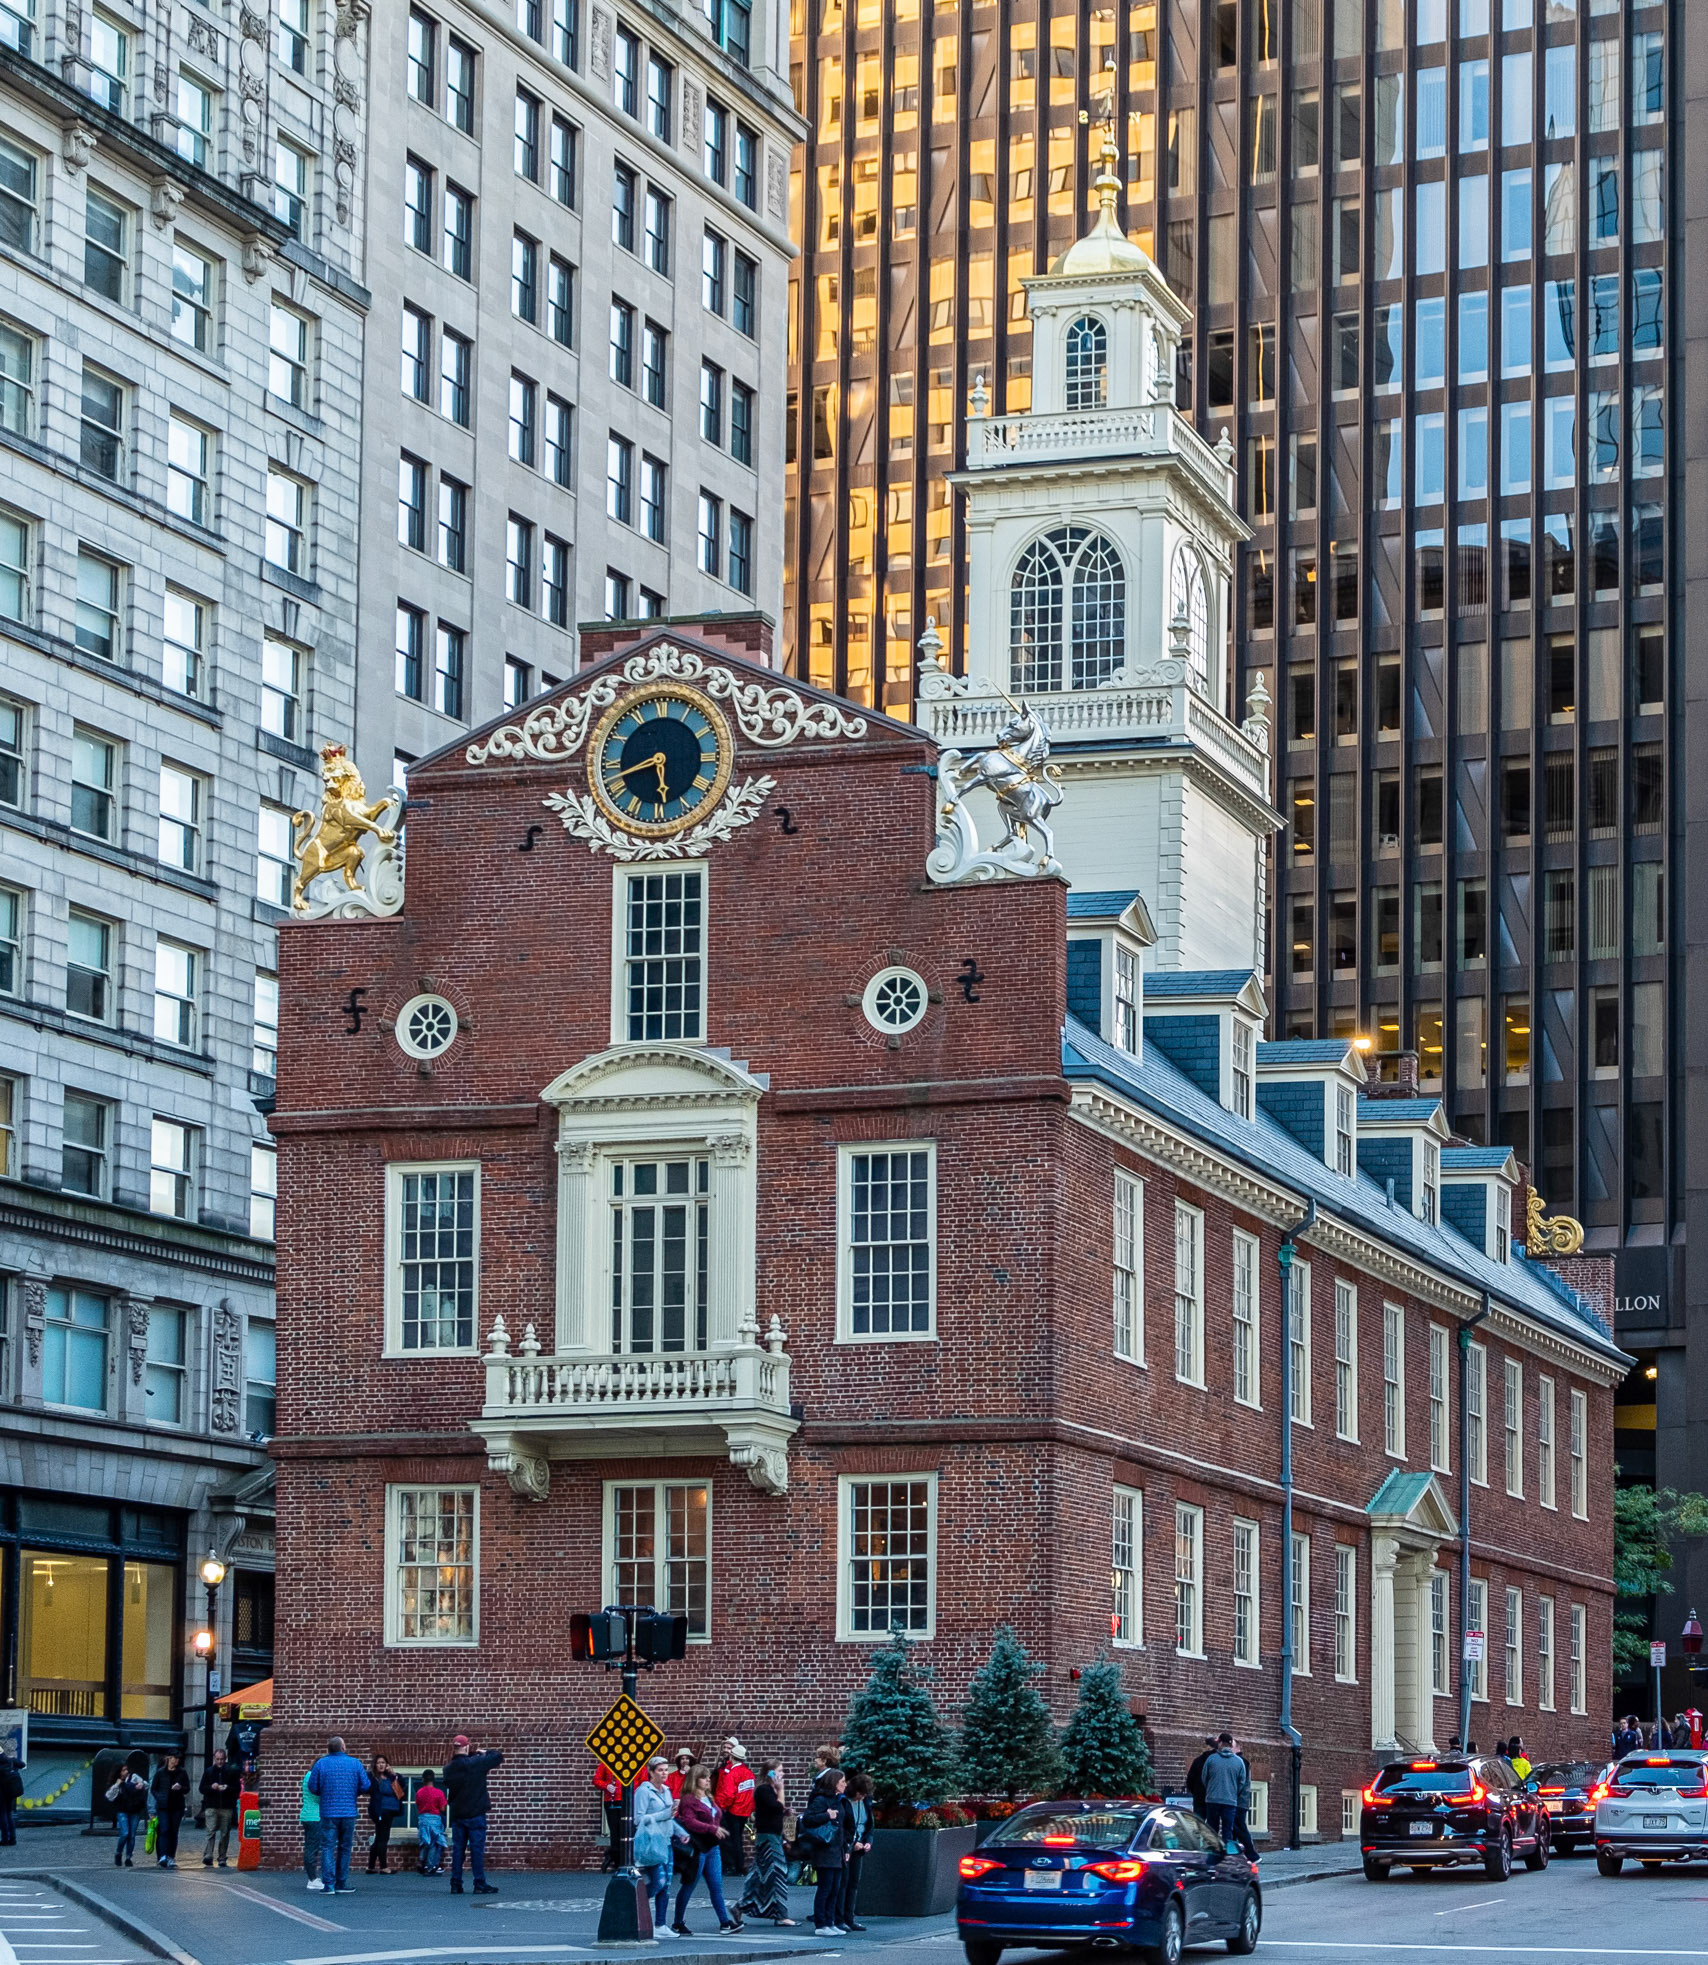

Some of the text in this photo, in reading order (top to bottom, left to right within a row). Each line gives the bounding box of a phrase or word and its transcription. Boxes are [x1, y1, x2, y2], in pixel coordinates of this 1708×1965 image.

[1614, 1295, 1661, 1311] LLON
[238, 1536, 264, 1550] STON
[245, 1818, 261, 1826] me
